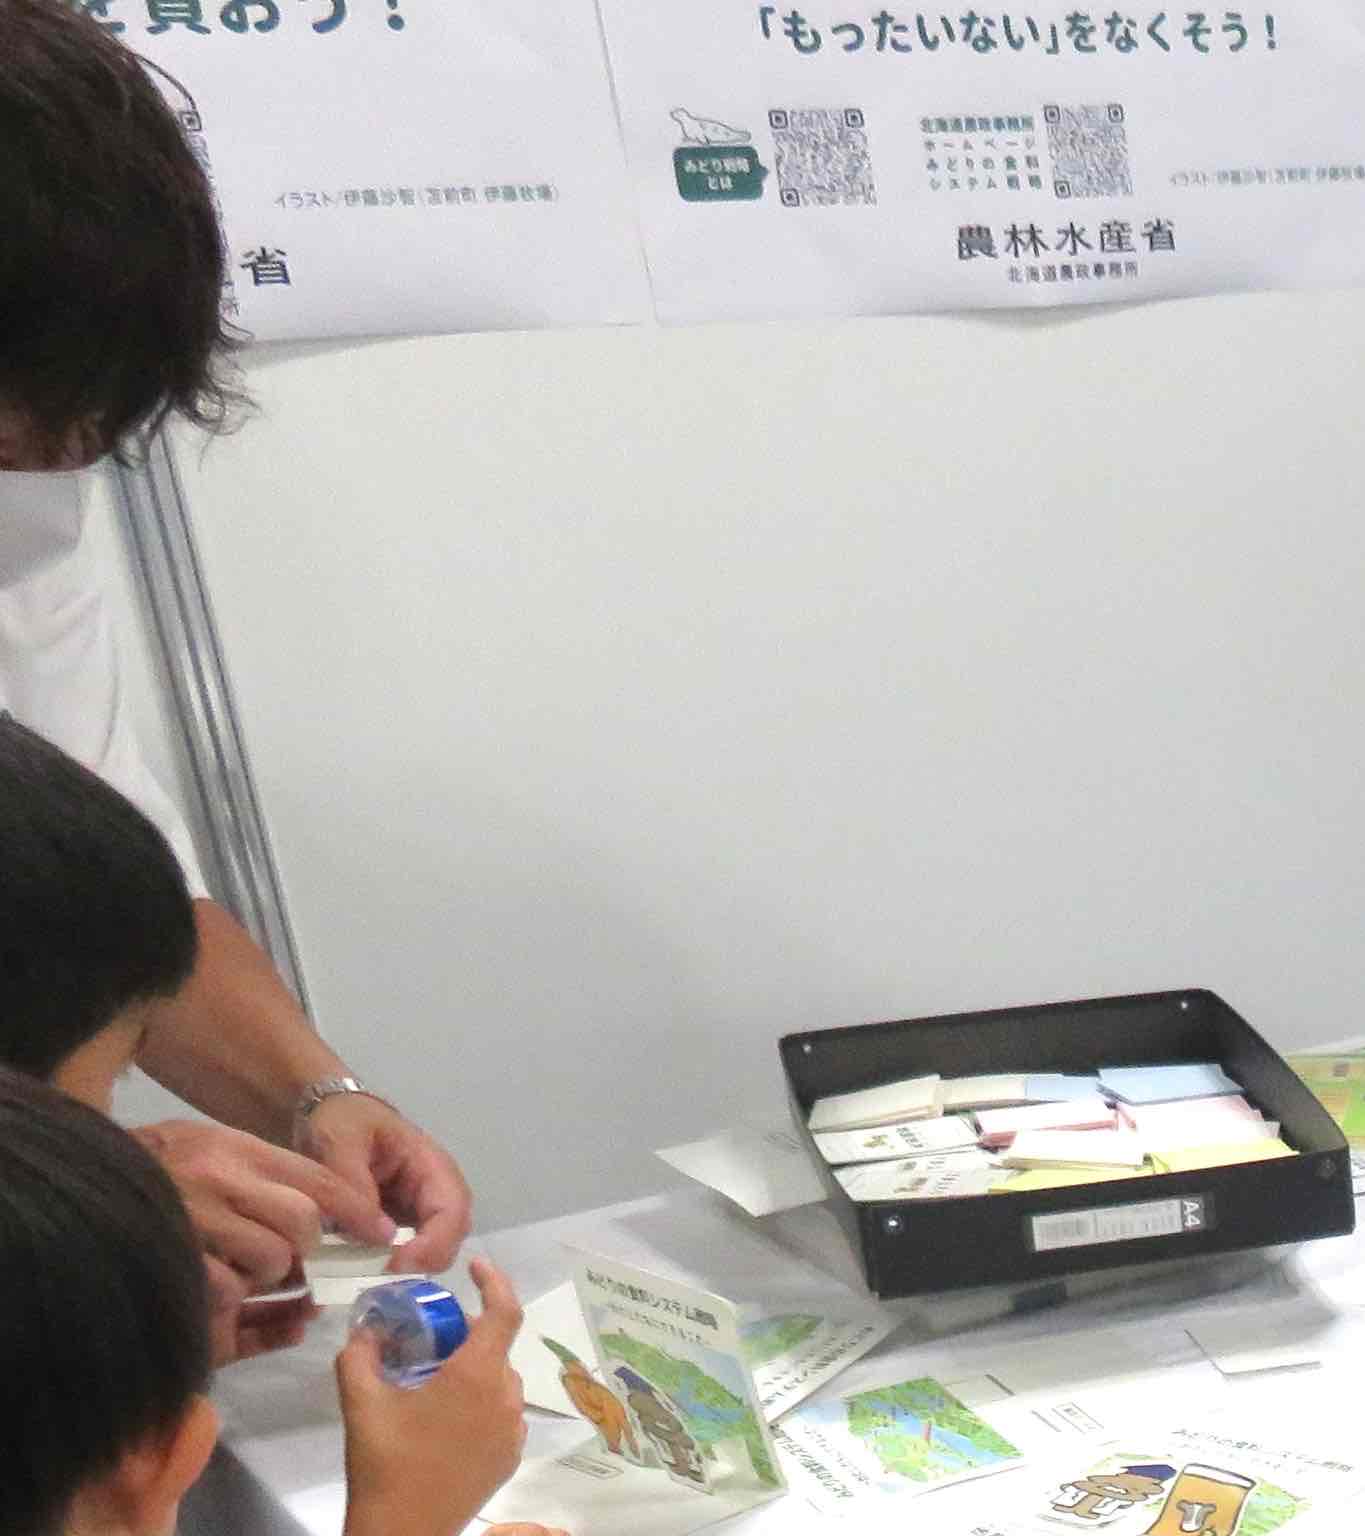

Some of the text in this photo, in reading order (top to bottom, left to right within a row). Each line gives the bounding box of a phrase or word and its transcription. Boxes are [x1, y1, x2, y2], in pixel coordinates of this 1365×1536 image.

[760, 6, 1279, 56] 「もったいない」をなくそう!
[957, 218, 1178, 261] 農林水産省
[239, 246, 292, 287] 省
[1007, 262, 1140, 284] 北海道農政事務所
[1182, 1200, 1201, 1227] A4
